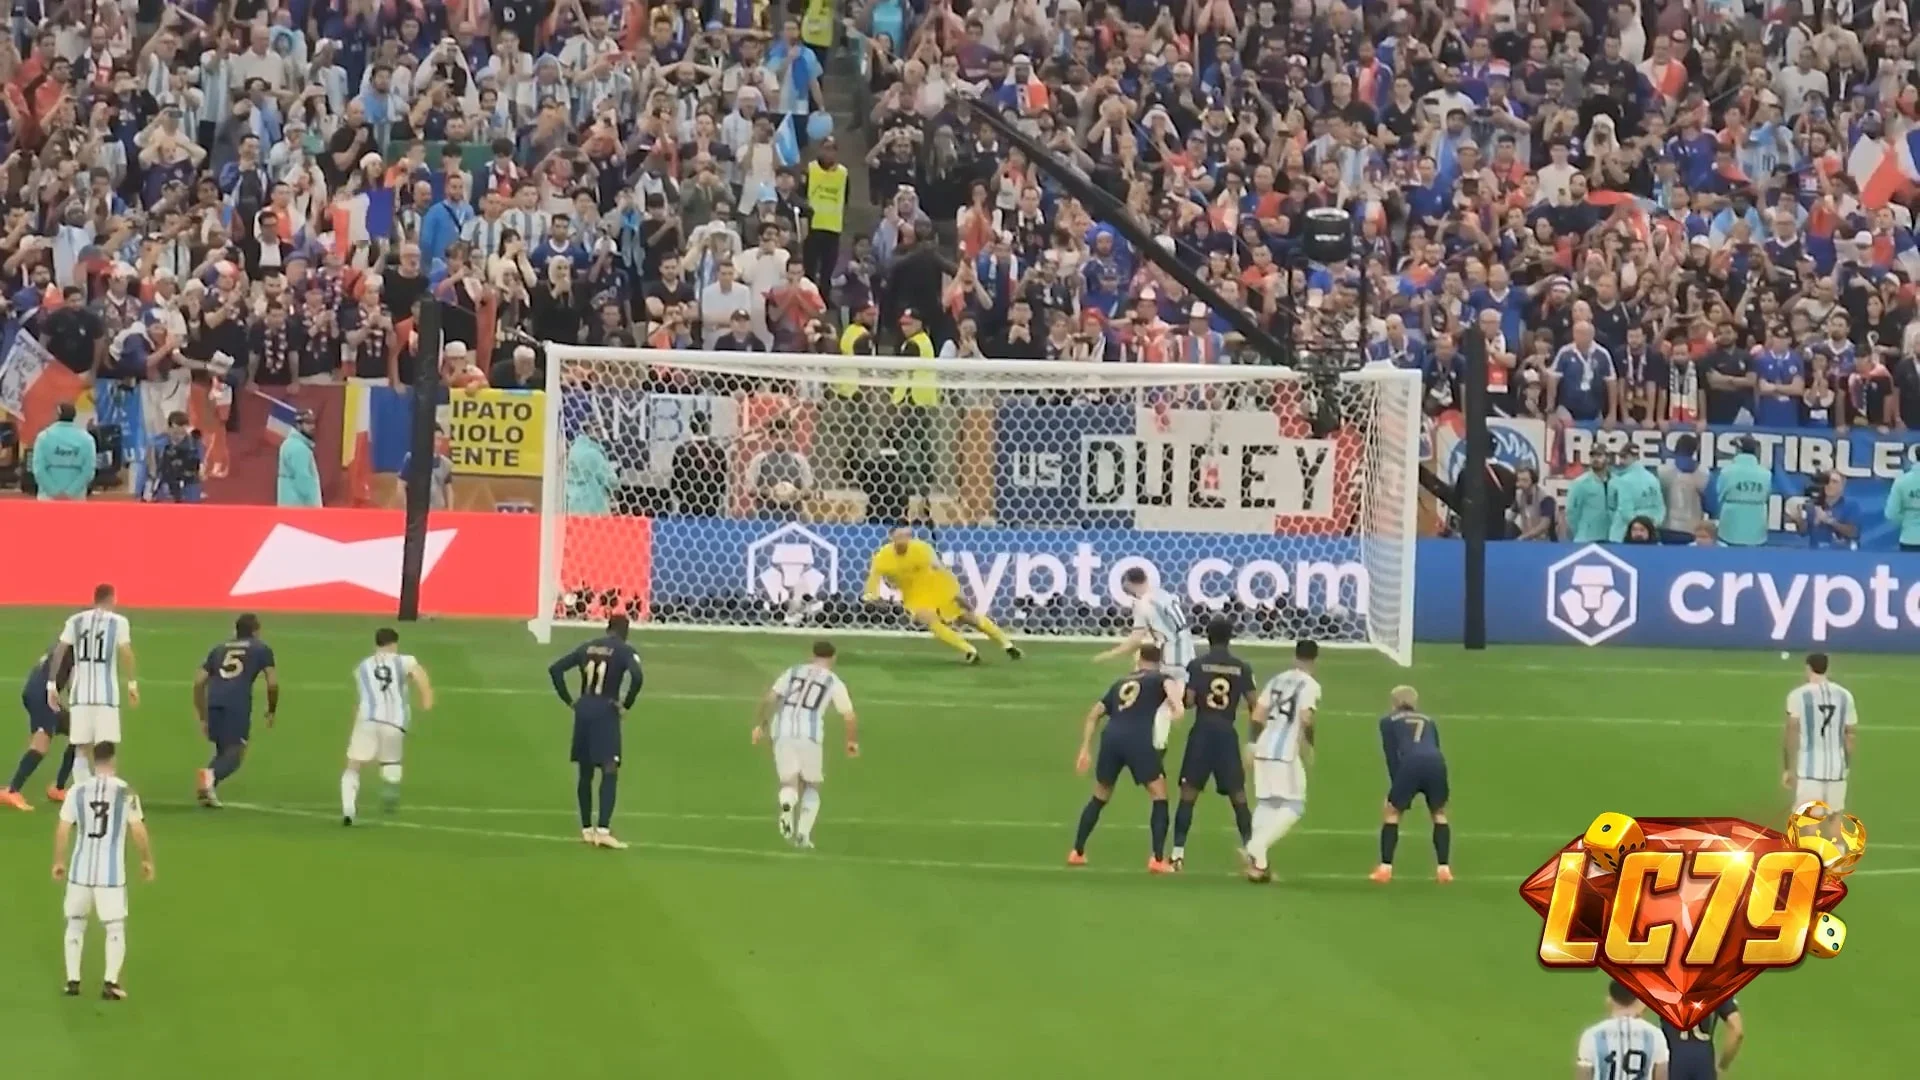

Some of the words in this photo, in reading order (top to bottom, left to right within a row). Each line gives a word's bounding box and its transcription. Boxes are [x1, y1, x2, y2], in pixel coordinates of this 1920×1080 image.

[1086, 440, 1329, 511] DUCEY
[1669, 564, 1920, 641] crypt
[79, 629, 107, 663] 11
[218, 649, 247, 679] 5
[374, 664, 393, 692] 9
[584, 660, 608, 695] 11
[782, 676, 827, 711] 20
[1118, 681, 1141, 711] 9
[1207, 677, 1230, 710] 8
[1405, 719, 1425, 743] 7
[1818, 704, 1836, 737] 7
[88, 801, 110, 839] 3
